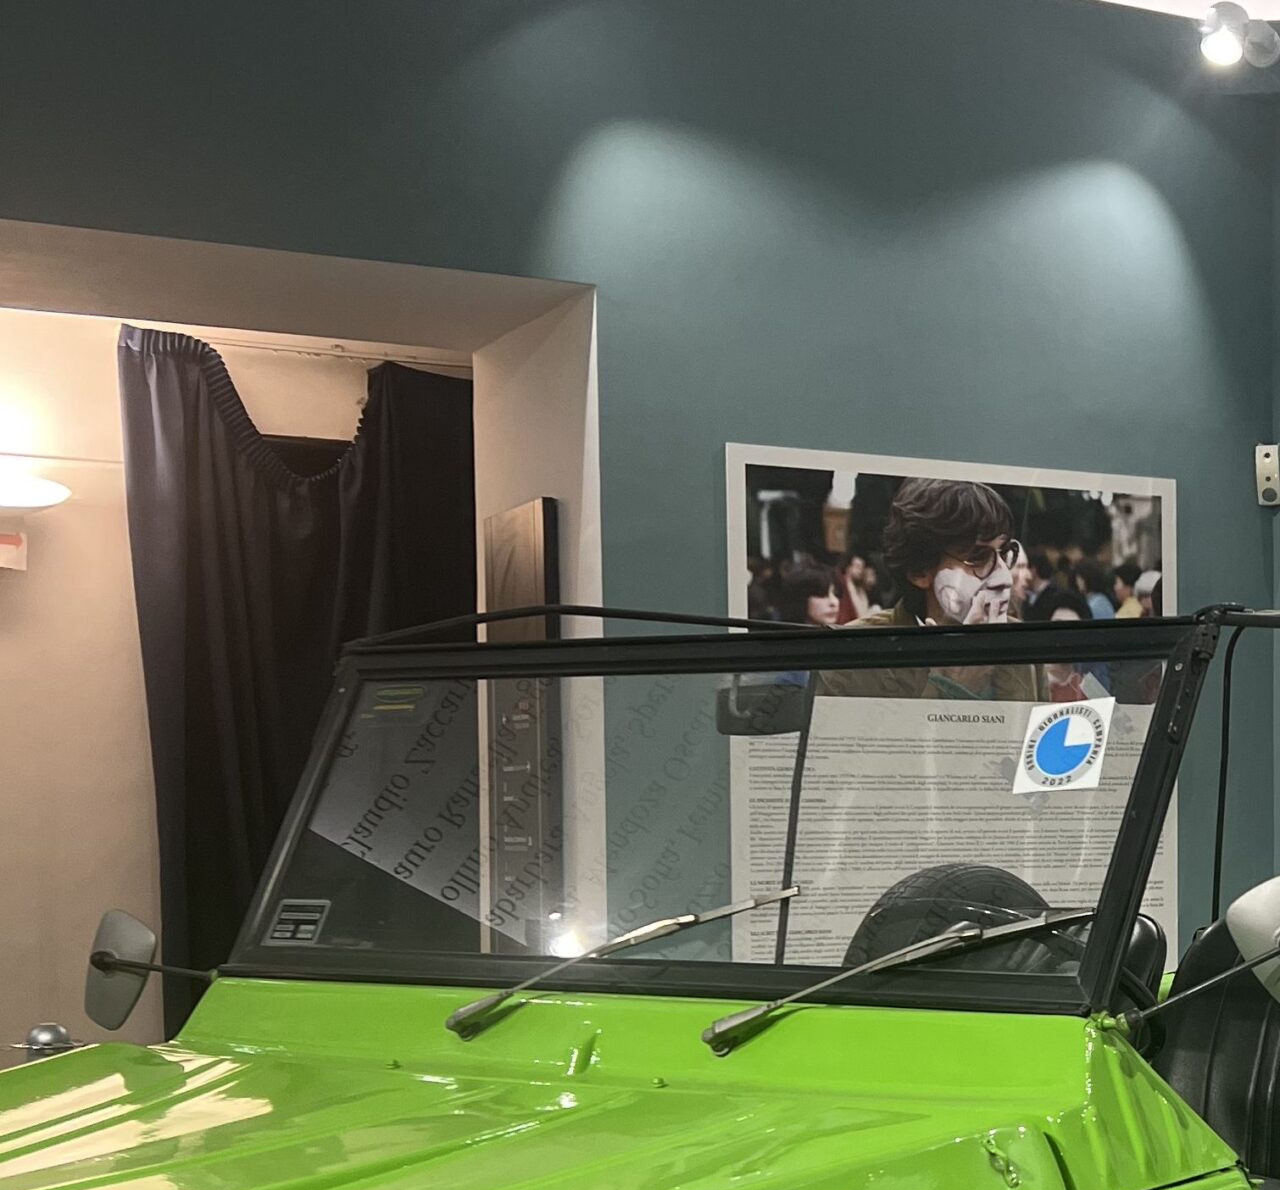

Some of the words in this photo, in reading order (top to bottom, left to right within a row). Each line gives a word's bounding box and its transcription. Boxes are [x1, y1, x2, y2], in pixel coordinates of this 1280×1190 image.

[927, 713, 980, 723] GIANCARLO
[981, 714, 1005, 724] SIANI
[1038, 706, 1092, 732] GIORNALISTI
[1085, 719, 1103, 766] CAMPANIA
[1041, 775, 1072, 786] 2022
